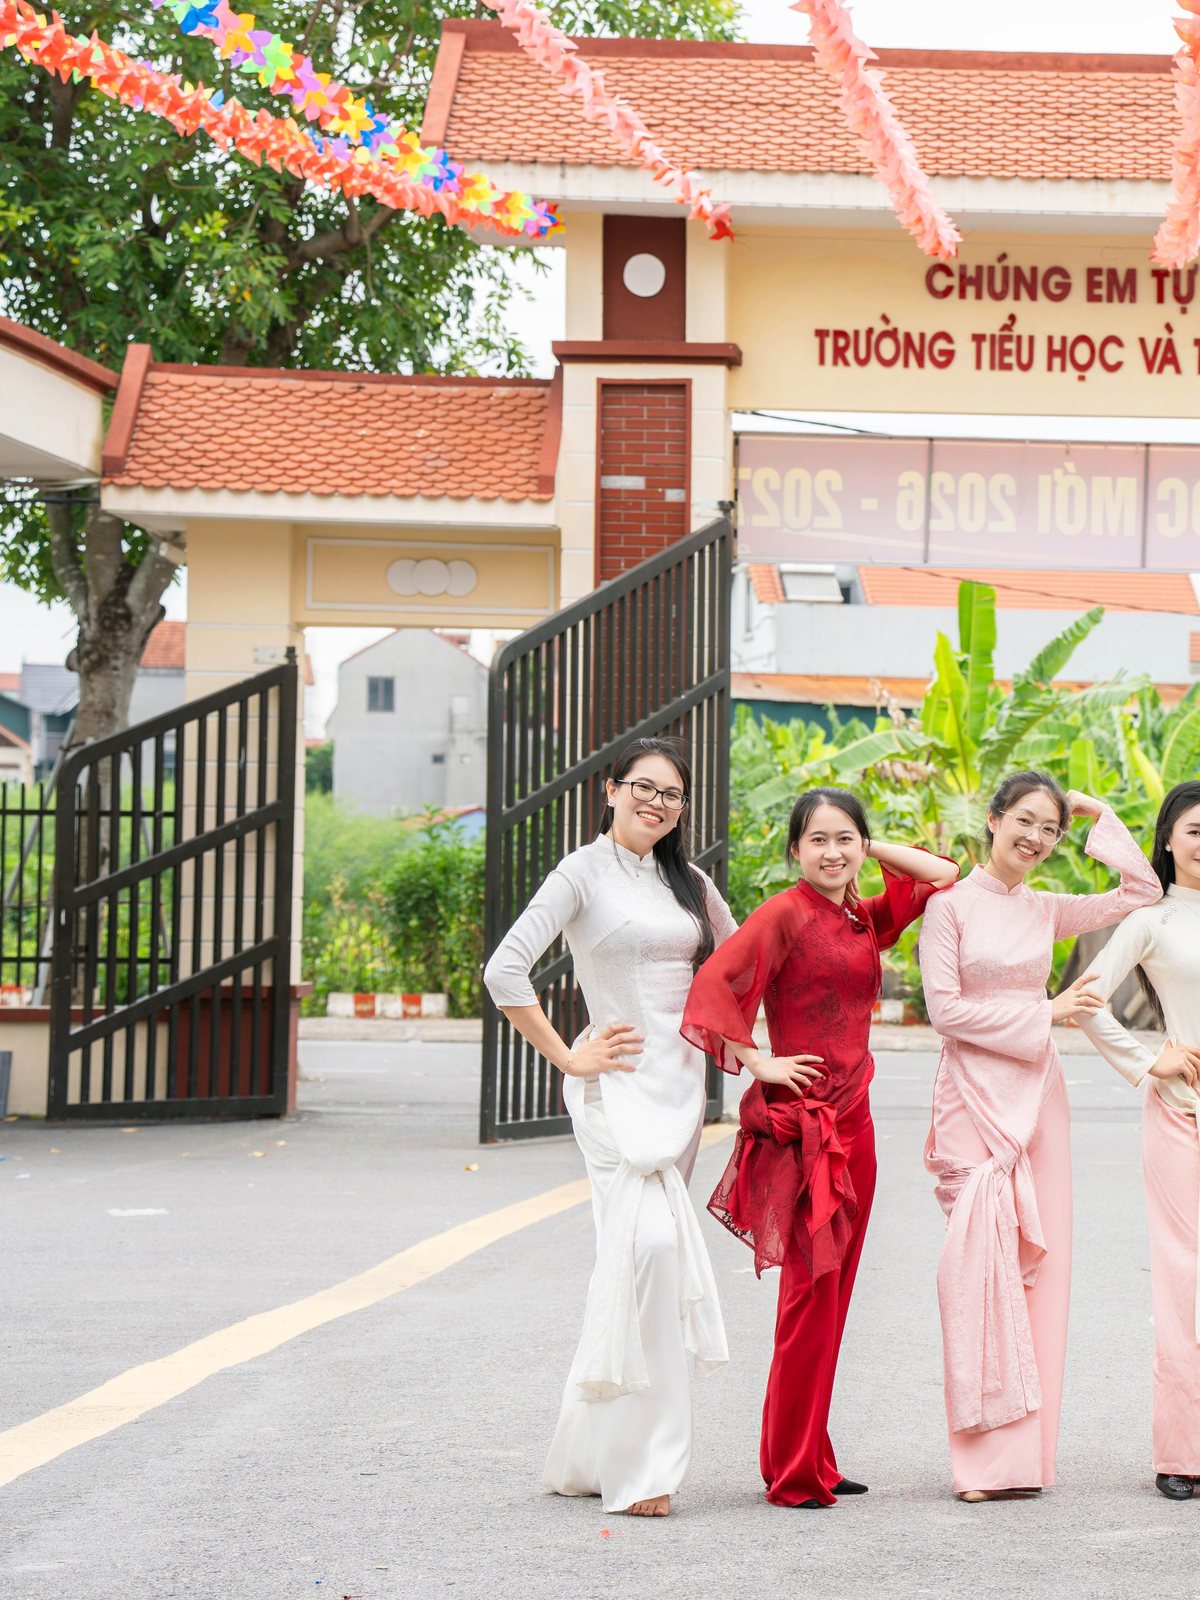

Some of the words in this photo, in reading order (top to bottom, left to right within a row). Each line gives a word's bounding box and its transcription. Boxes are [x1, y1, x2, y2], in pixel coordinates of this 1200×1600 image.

[925, 253, 1072, 300] CHÚNG
[1086, 267, 1136, 304] EM
[1151, 264, 1200, 315] TỰ
[814, 313, 956, 369] TRƯỜNG
[971, 313, 1035, 371] TIỂU
[1046, 334, 1124, 381] HỌC
[1139, 322, 1181, 375] VÀ
